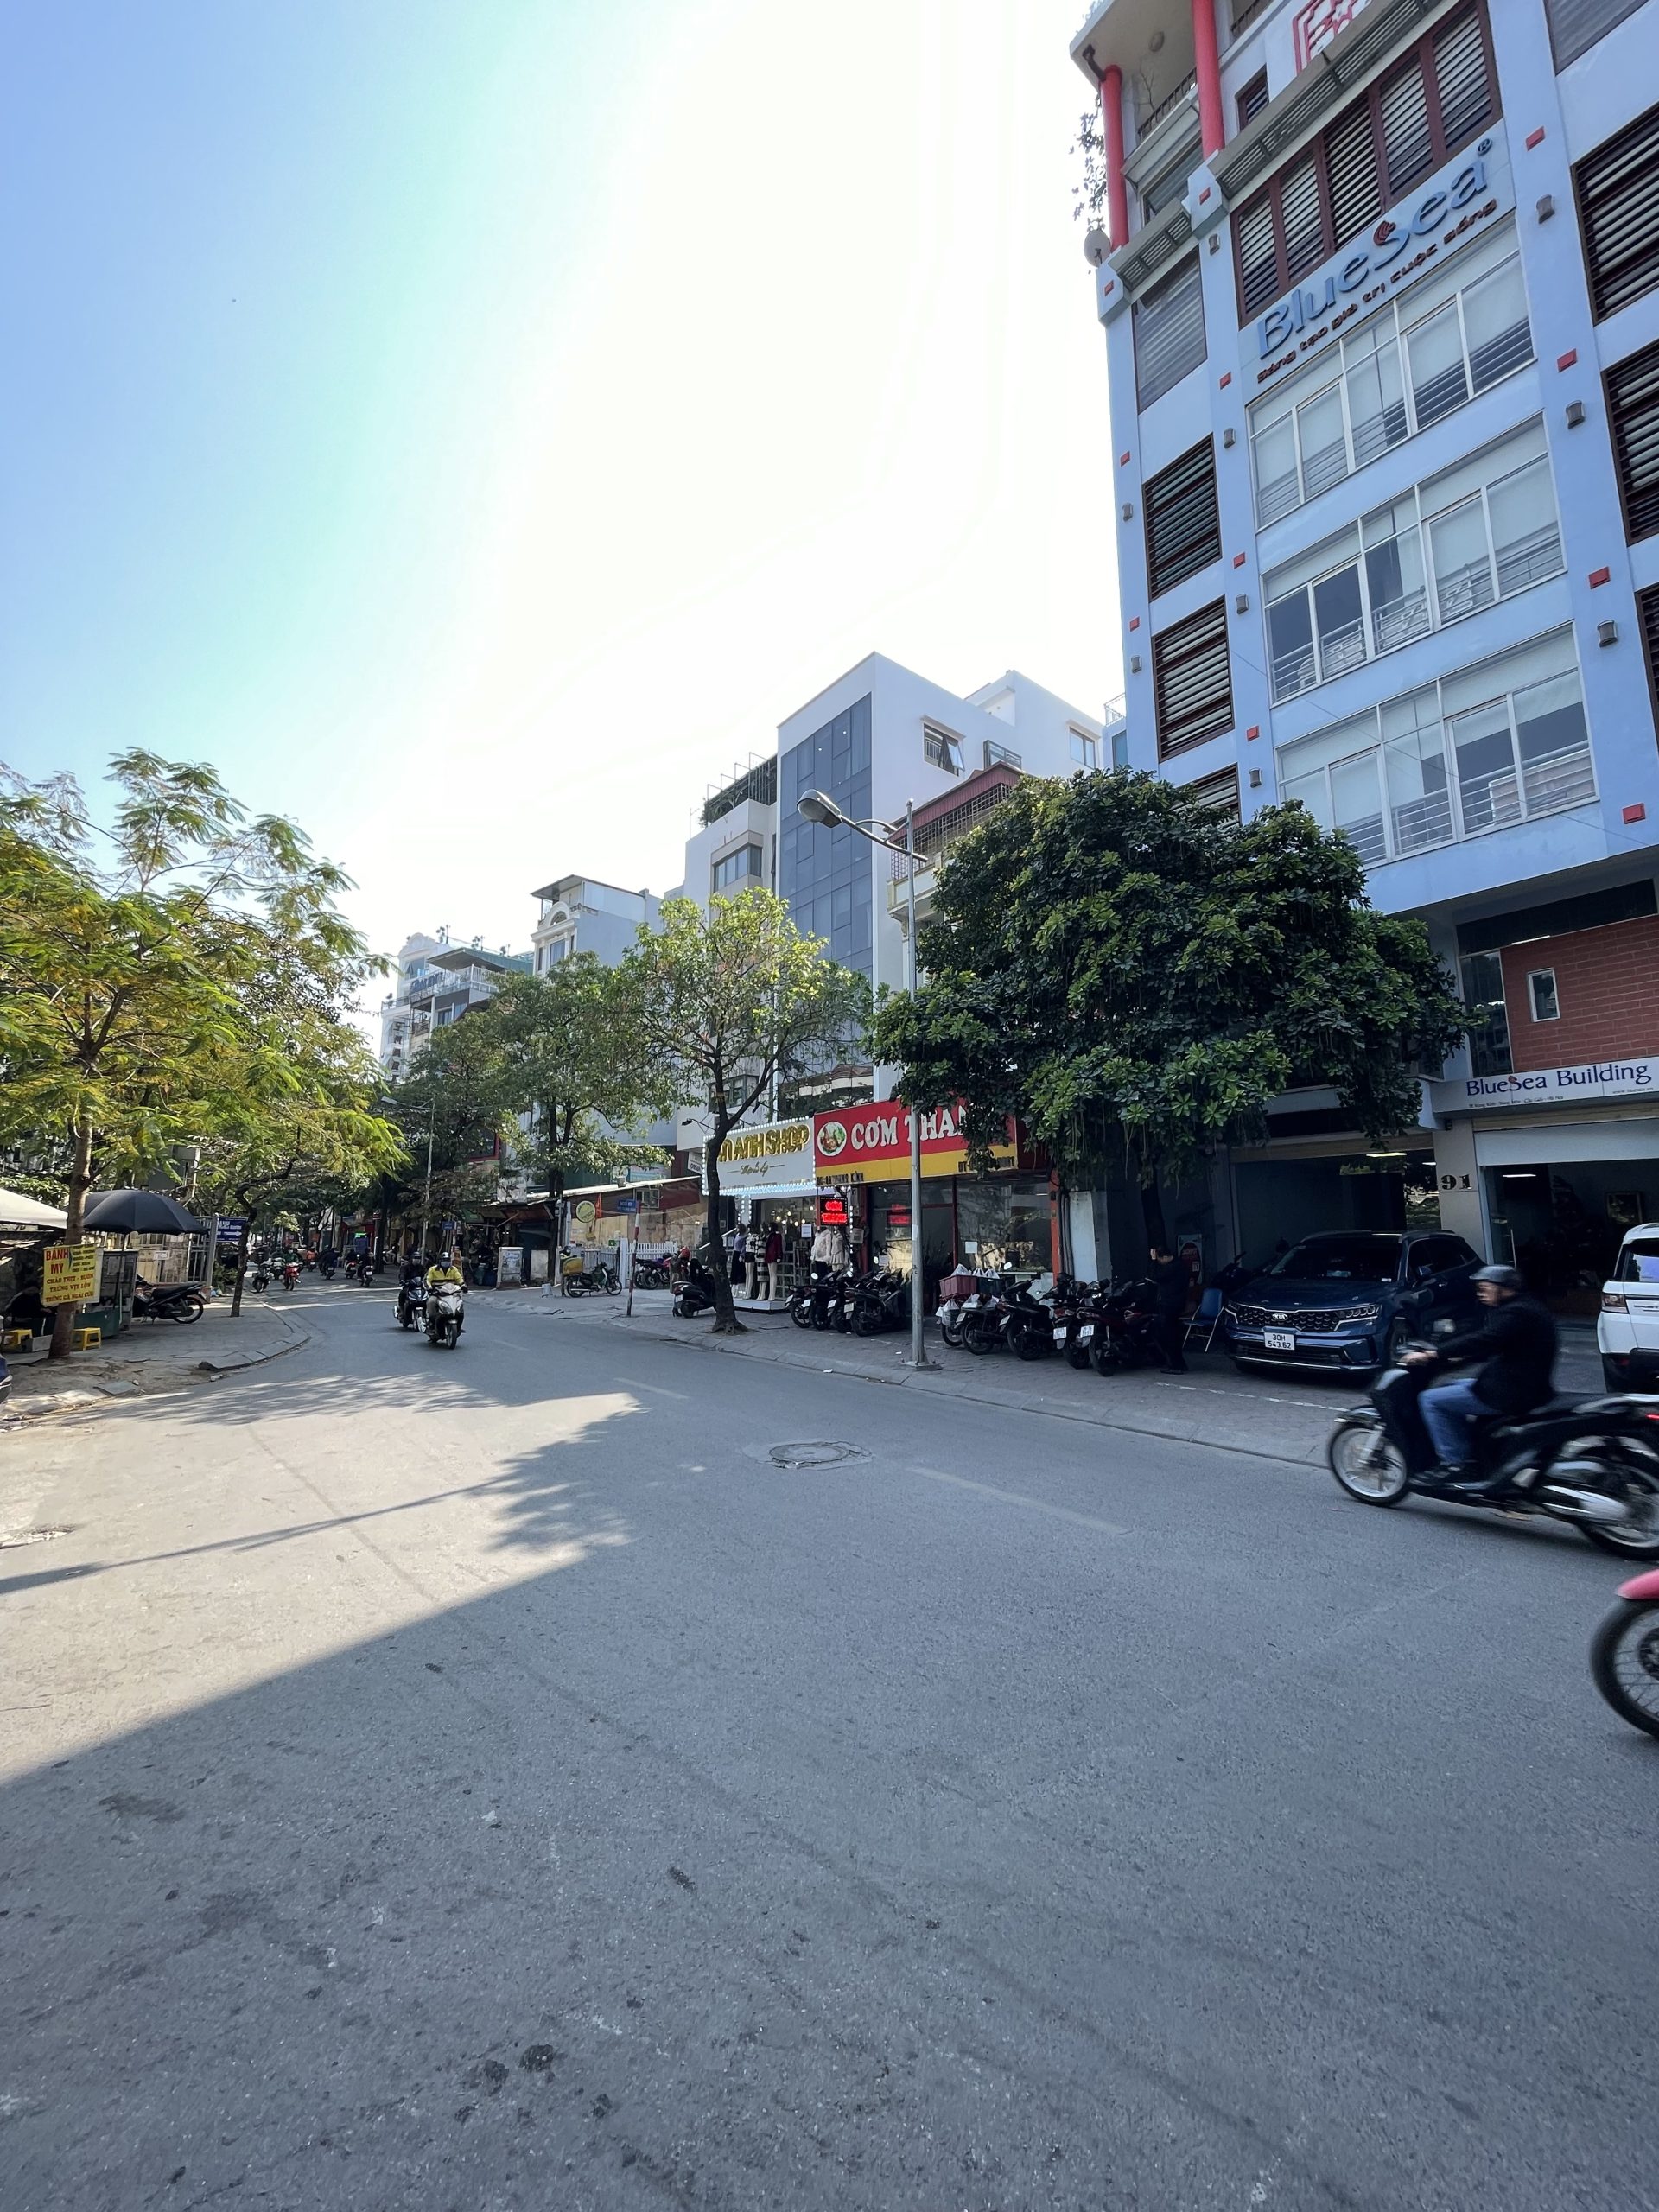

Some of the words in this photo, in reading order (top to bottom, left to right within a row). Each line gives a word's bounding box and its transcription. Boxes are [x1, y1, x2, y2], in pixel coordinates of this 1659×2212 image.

[1466, 1076, 1547, 1096] BlueSea
[1556, 1064, 1652, 1085] Building
[766, 1124, 810, 1156] SHOP
[851, 1116, 899, 1151] CƠM
[1440, 1174, 1472, 1191] 91
